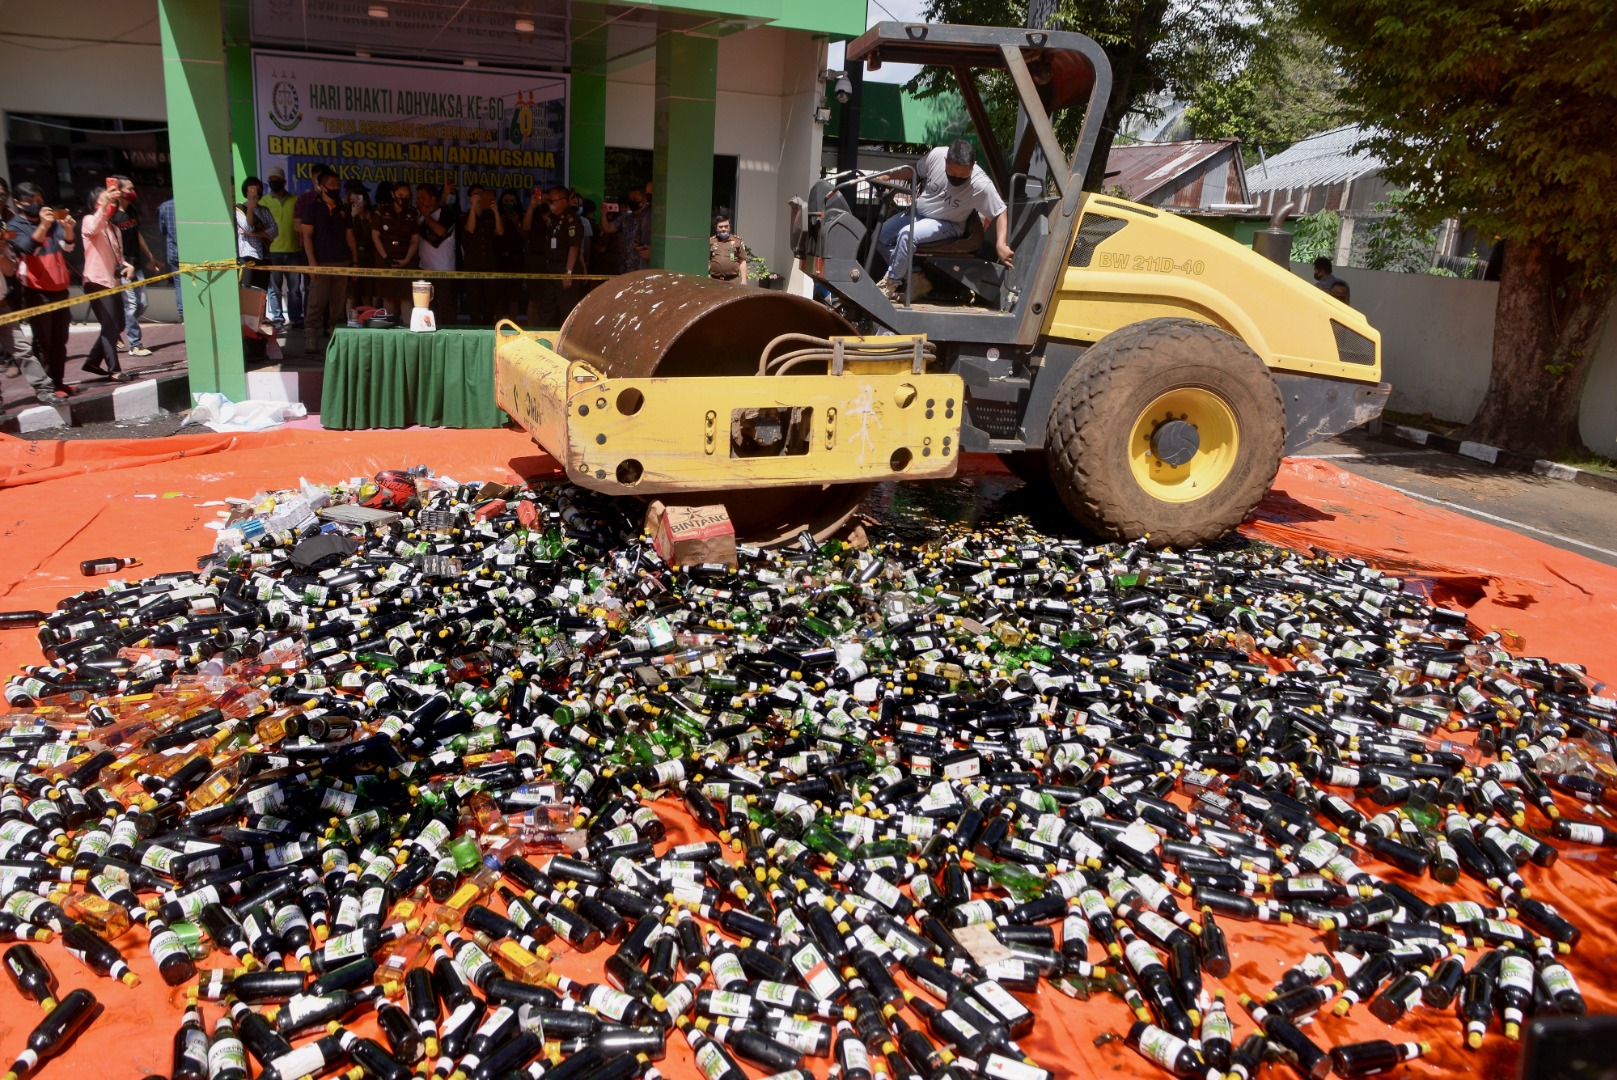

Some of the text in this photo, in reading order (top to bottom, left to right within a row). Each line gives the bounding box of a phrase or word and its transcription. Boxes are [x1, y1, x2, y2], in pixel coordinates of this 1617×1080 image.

[309, 83, 341, 111] HARI
[344, 86, 393, 114] BHAKTI
[396, 89, 464, 119] ADHYAKSA
[467, 94, 505, 122] KE-60
[317, 116, 357, 134] "TERUS
[359, 120, 414, 138] BERGERAK
[416, 123, 438, 139] DAN
[440, 126, 498, 143] BERKARYA"
[268, 135, 338, 158] BHAKTI
[341, 139, 405, 161] SOSIAL
[408, 143, 445, 163] DAN
[447, 146, 556, 169] ANJANGSANA
[463, 170, 534, 190] MANADO
[1098, 251, 1206, 276] BW 211D-40
